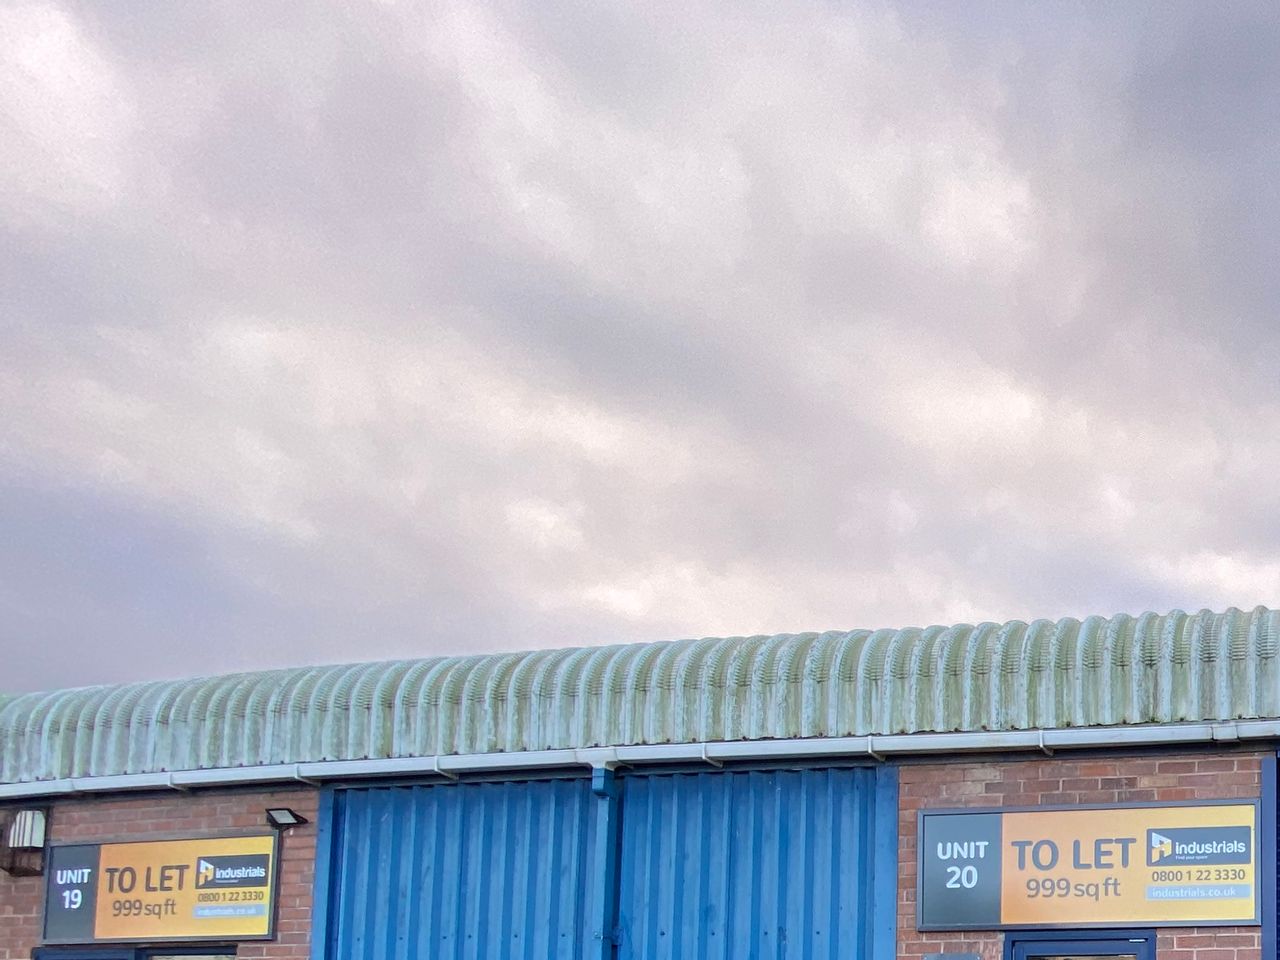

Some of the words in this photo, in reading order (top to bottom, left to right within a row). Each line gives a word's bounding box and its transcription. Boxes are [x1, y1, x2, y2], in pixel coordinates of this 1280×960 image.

[937, 841, 989, 860] UNIT
[1011, 839, 1059, 871] TO
[1073, 837, 1137, 870] LET
[1175, 840, 1246, 855] industrials
[56, 868, 91, 884] UNIT
[105, 866, 137, 893] TO
[145, 864, 189, 892] LET
[215, 866, 266, 878] industrials
[945, 865, 978, 889] 20
[1152, 870, 1183, 882] 0800
[1186, 870, 1192, 881] 1
[1196, 869, 1211, 881] 22
[1214, 868, 1246, 881] 3330
[228, 891, 240, 901] 22
[241, 891, 264, 901] 3330
[1026, 877, 1071, 898] 999
[1073, 882, 1099, 901] sq
[1102, 877, 1121, 897] ft
[1152, 887, 1237, 898] industrials.co.uk
[62, 889, 82, 909] 19
[113, 899, 142, 917] 999
[144, 903, 162, 919] sq
[164, 898, 177, 915] ft
